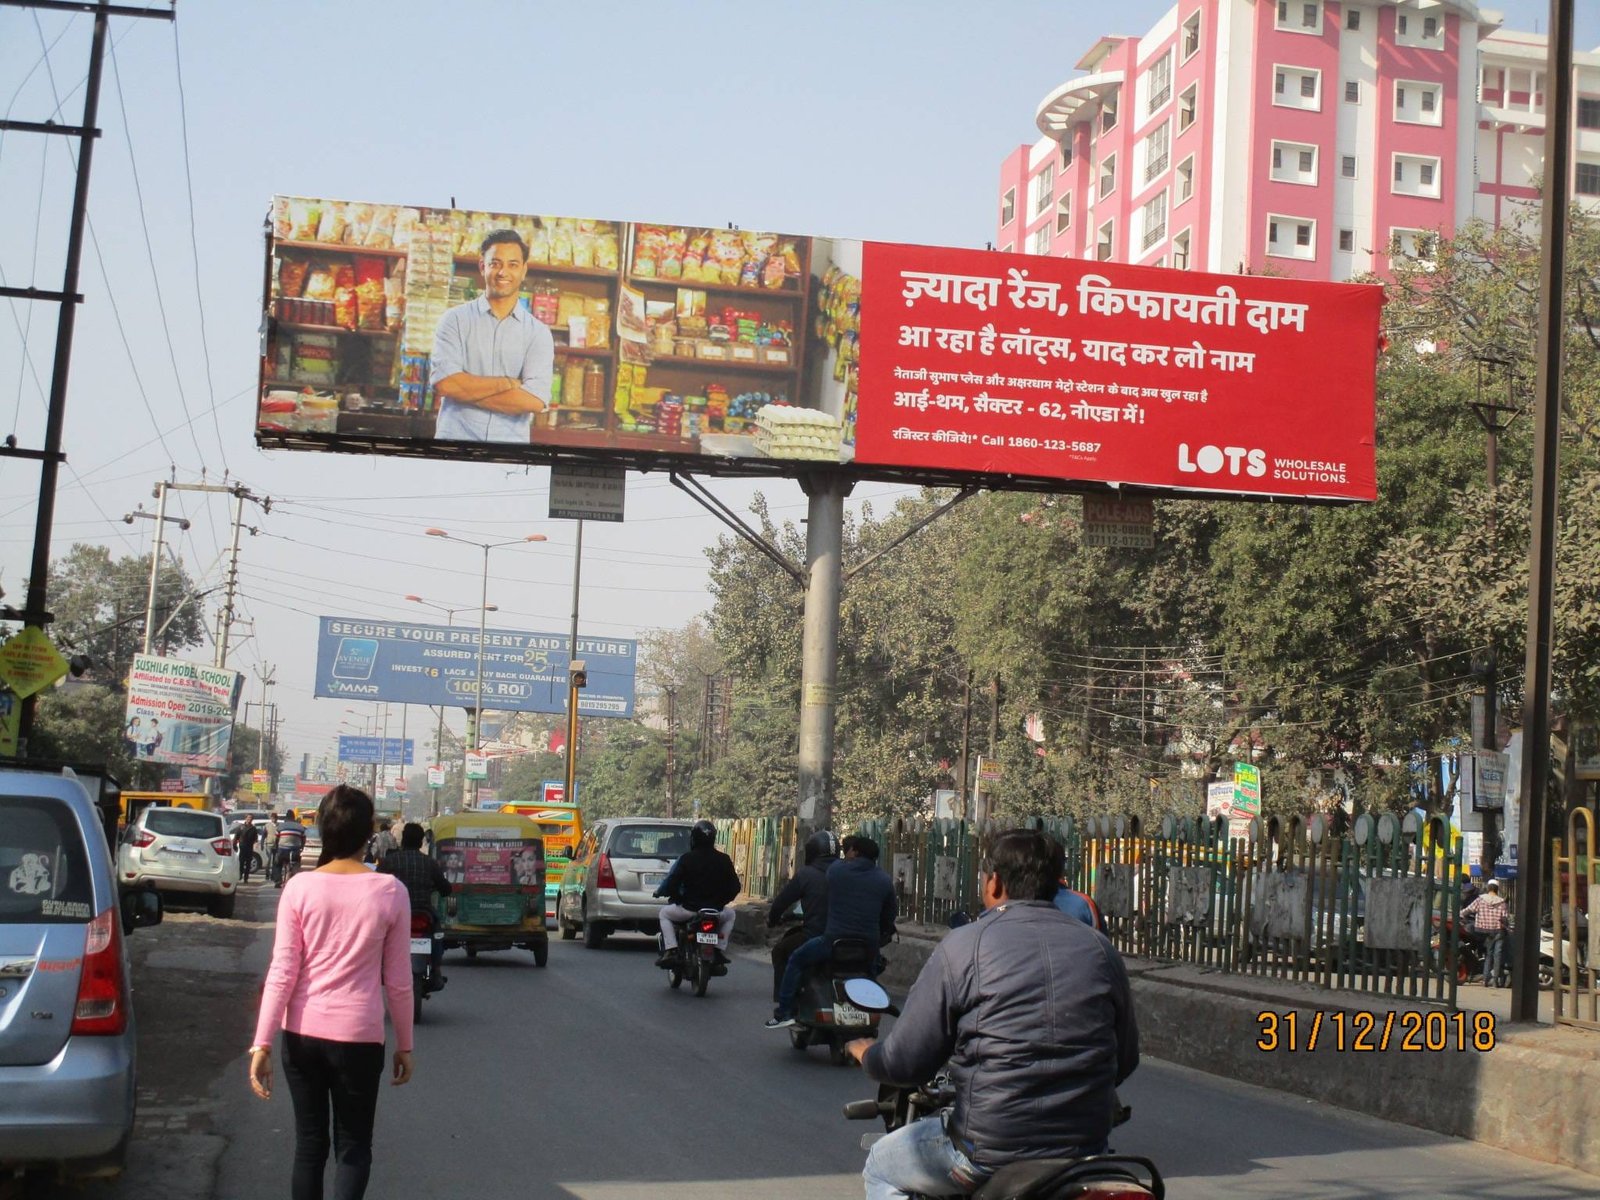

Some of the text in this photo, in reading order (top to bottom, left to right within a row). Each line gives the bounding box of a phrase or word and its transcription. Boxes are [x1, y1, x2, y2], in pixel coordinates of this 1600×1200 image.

[900, 268, 1309, 335] ज़्यादा रेंज, किफायती दाम
[898, 323, 1256, 373] आ रहा है लॉट्स, याद कर लो नाम
[893, 366, 1208, 403] नेताजी सुभाष प्लेस और अक्षरधाम मेट्रो स्टेशन के बाद अब खुल रहा है
[893, 388, 970, 413] आई-थम,
[973, 392, 1024, 415] सैक्टर
[1039, 402, 1066, 421] 62,
[1070, 399, 1120, 422] नोएडा
[892, 427, 929, 441] रजिस्टर
[982, 434, 1004, 446] Call
[1008, 437, 1101, 453] 1860-123-5687
[1178, 443, 1267, 478] LOTS
[1274, 458, 1346, 473] WHOLESALE
[332, 622, 396, 638] SECURE
[402, 628, 445, 642] YOUR
[450, 632, 523, 647] PRESENT
[528, 638, 560, 650] AND
[423, 648, 548, 673] ASSURED RENT FOR 25
[134, 672, 163, 683] Affiliated
[213, 686, 230, 697] Delhi
[135, 659, 231, 688] SUSHILA MODEL SCHOOL
[392, 664, 422, 673] INVEST
[496, 672, 517, 680] BACK
[520, 674, 566, 683] GUARANTEE
[339, 682, 379, 694] MMR
[453, 681, 525, 696] 100% ROI
[130, 695, 166, 709] Admission
[167, 700, 186, 711] Open
[136, 707, 154, 717] Class
